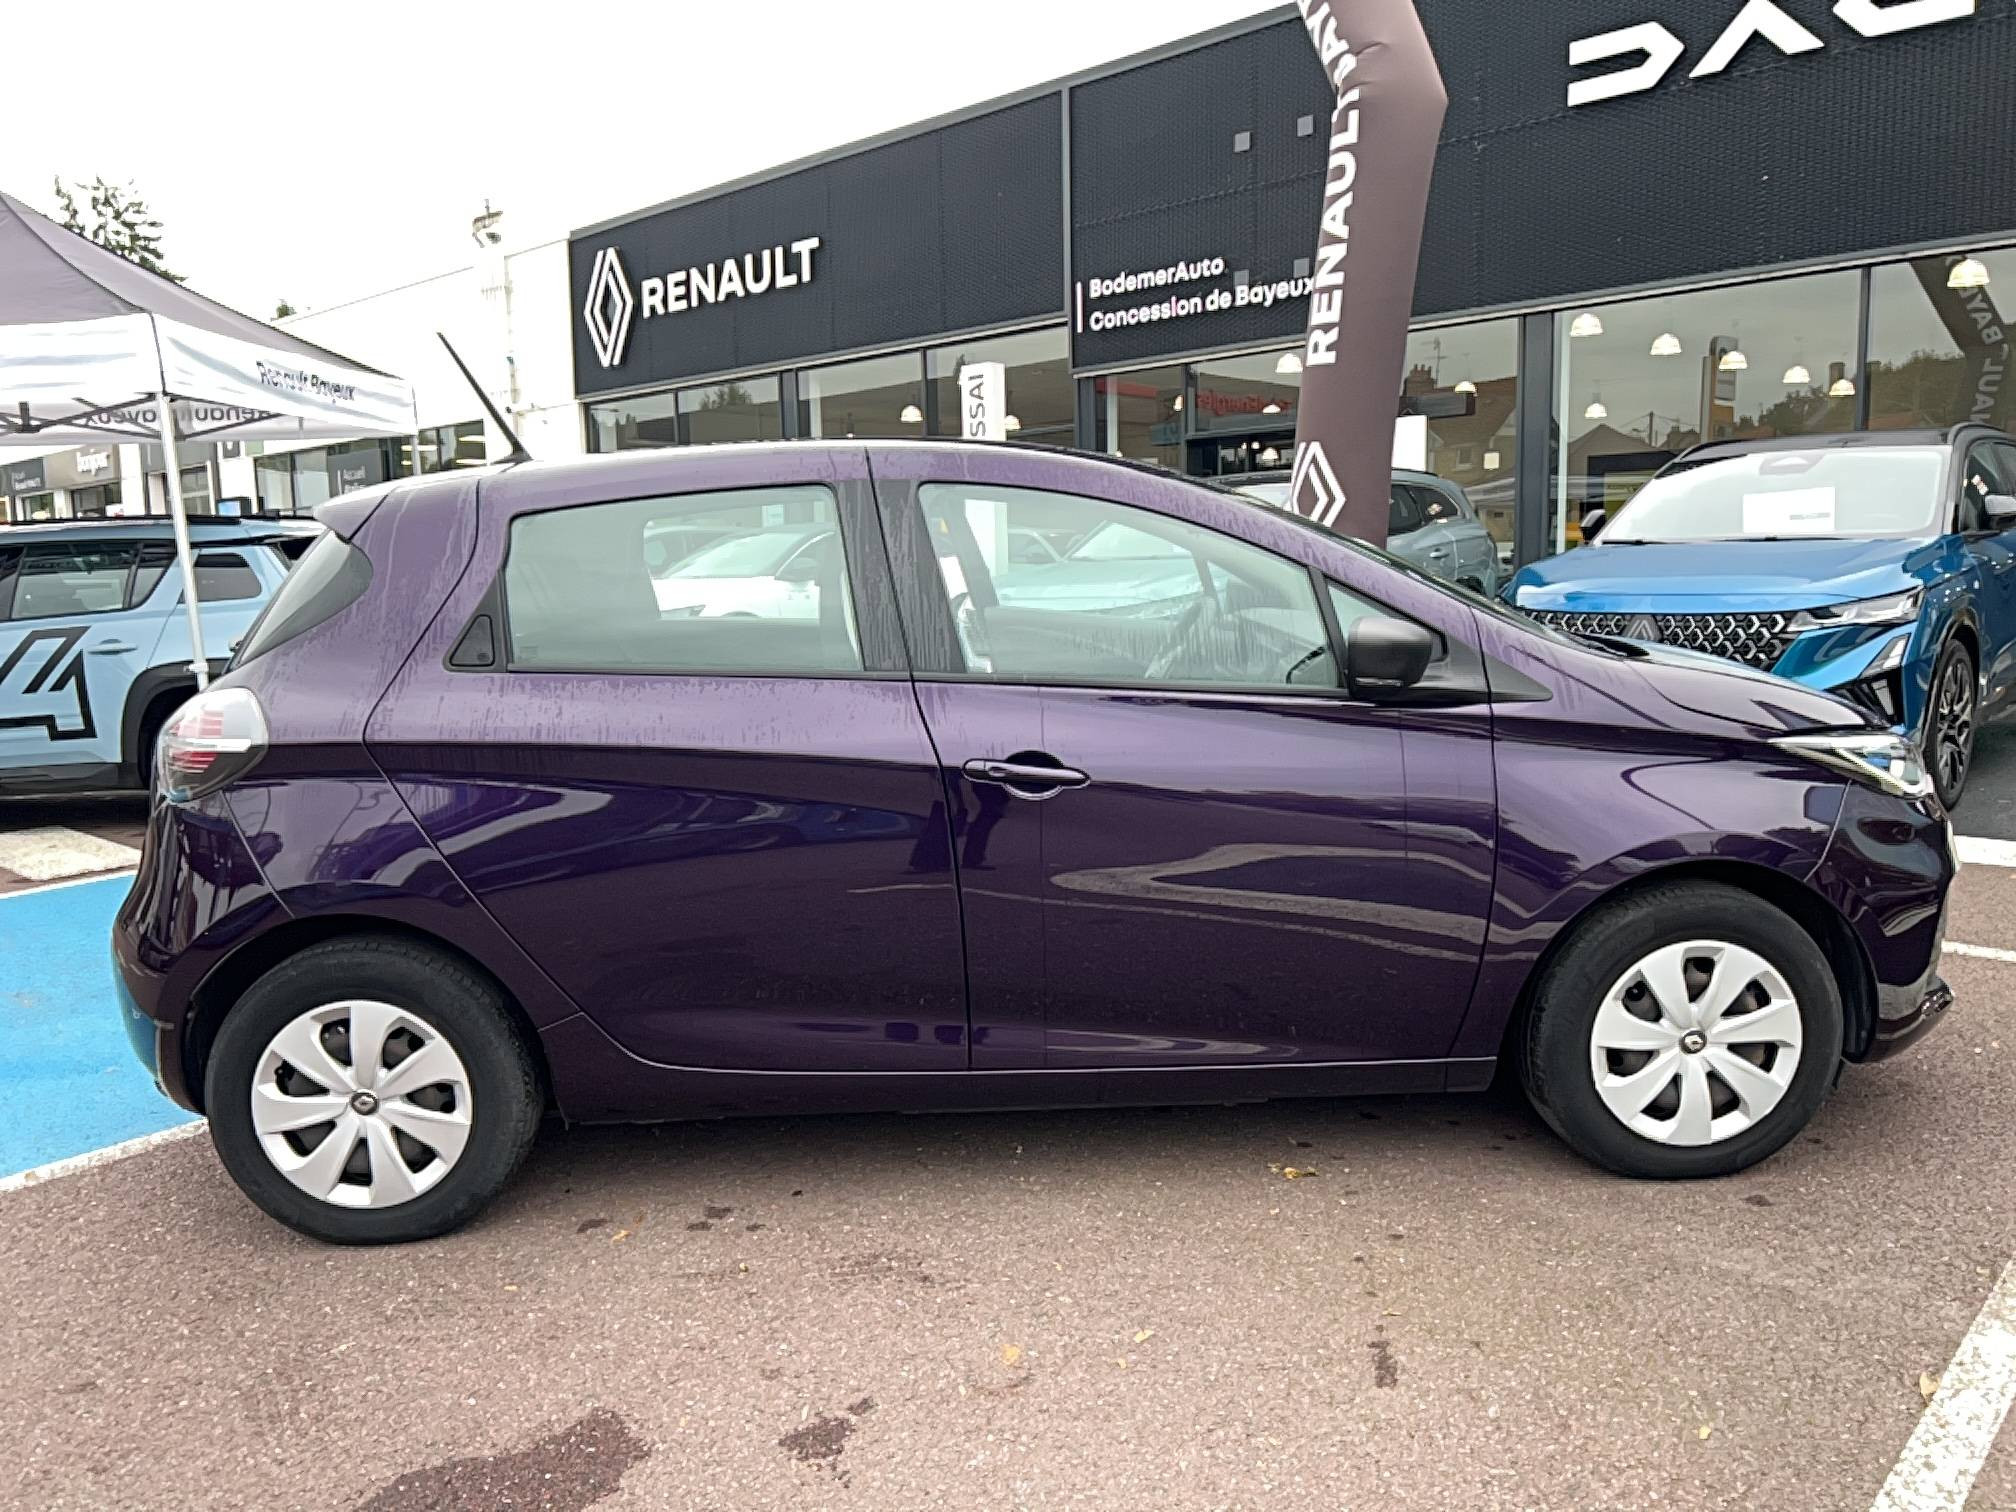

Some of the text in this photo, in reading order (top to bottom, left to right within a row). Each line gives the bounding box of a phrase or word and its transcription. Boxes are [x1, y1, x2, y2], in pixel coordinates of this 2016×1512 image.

[1567, 0, 1976, 107] DAC
[1306, 86, 1361, 366] RENAULT
[640, 236, 820, 320] RENAULT
[1089, 256, 1225, 299] BodemerAuto
[1089, 276, 1316, 332] Concession de Bayeux
[967, 374, 986, 437] SSAI
